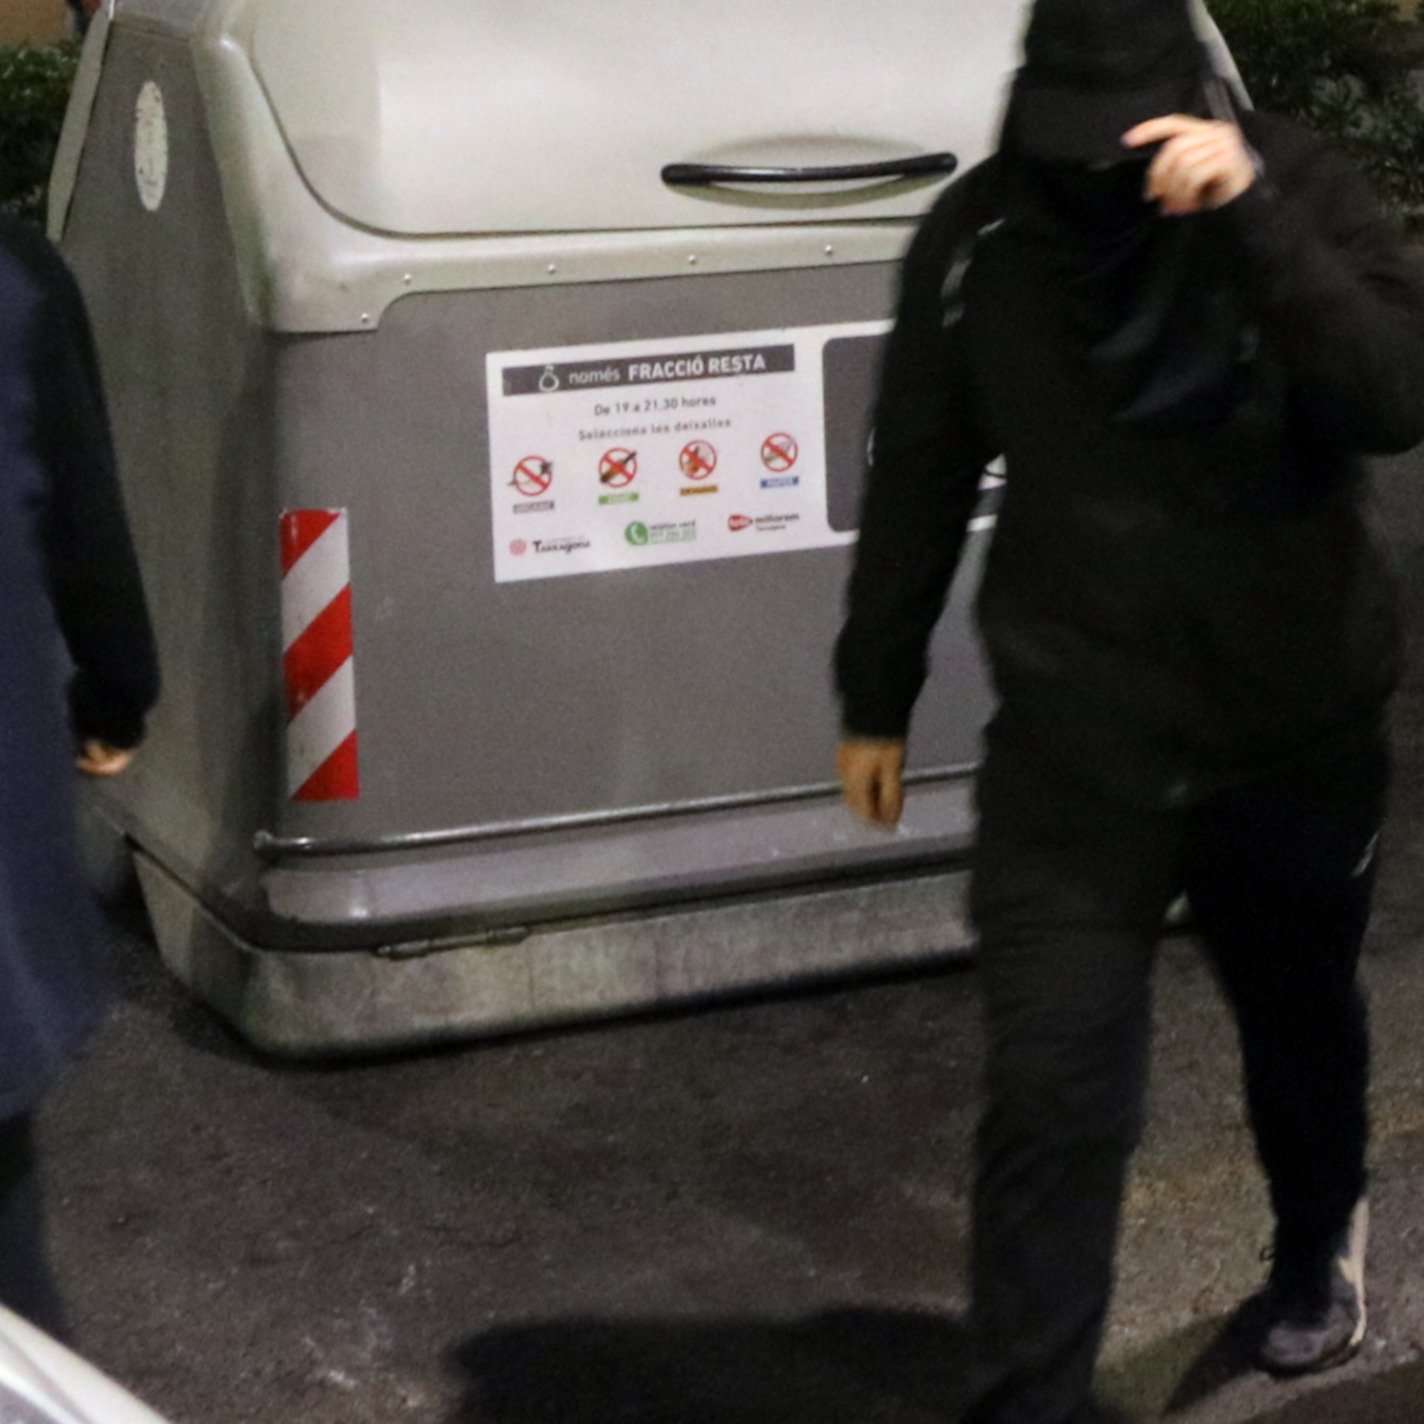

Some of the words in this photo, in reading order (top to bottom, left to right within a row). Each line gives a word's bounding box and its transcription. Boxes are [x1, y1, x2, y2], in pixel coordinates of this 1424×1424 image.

[569, 365, 620, 385] només
[628, 356, 704, 381] FRACCIÓ
[708, 354, 766, 374] RESTA
[594, 404, 610, 416] De
[616, 402, 630, 414] 19
[681, 395, 717, 409] hores
